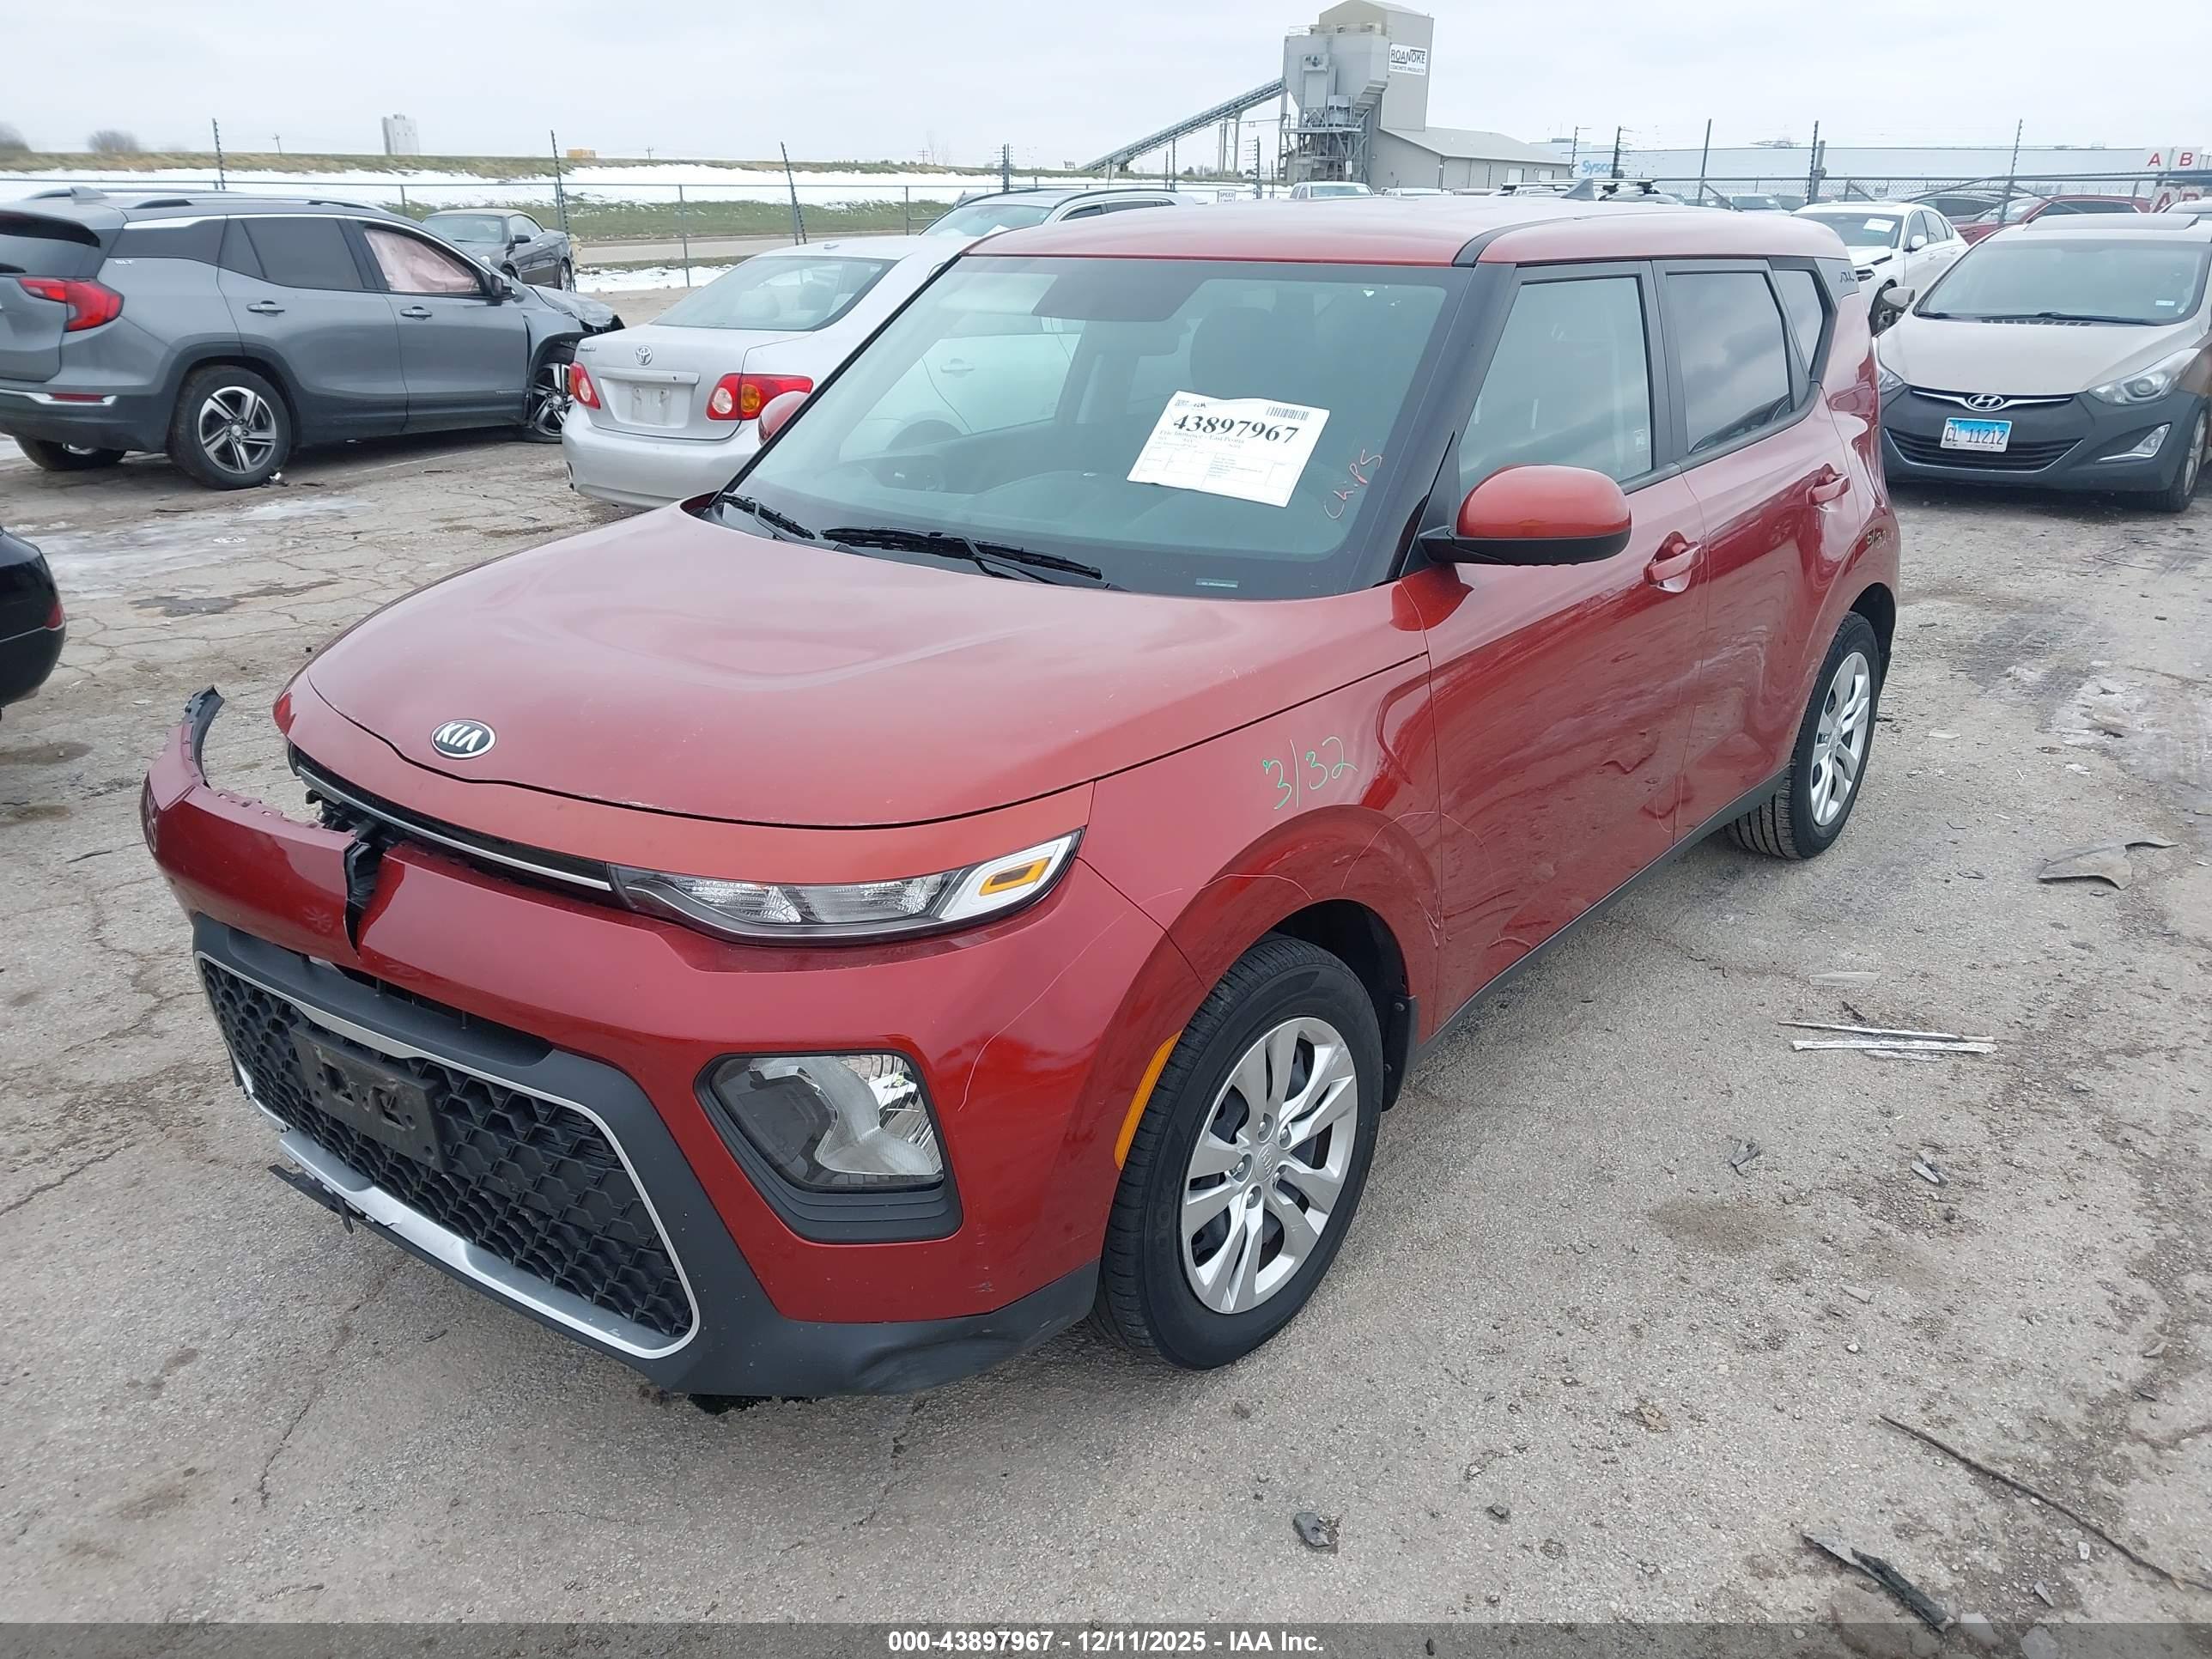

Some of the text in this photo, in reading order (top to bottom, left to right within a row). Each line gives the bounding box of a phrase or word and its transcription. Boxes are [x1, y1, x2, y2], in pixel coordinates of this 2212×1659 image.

[1390, 49, 1425, 64] ROANOKE
[2147, 152, 2161, 167] A
[2179, 152, 2193, 167] B
[1173, 414, 1299, 444] 43897967
[1945, 427, 2006, 446] CL 11212
[434, 722, 484, 752] KIA
[1262, 736, 1359, 811] 3/32
